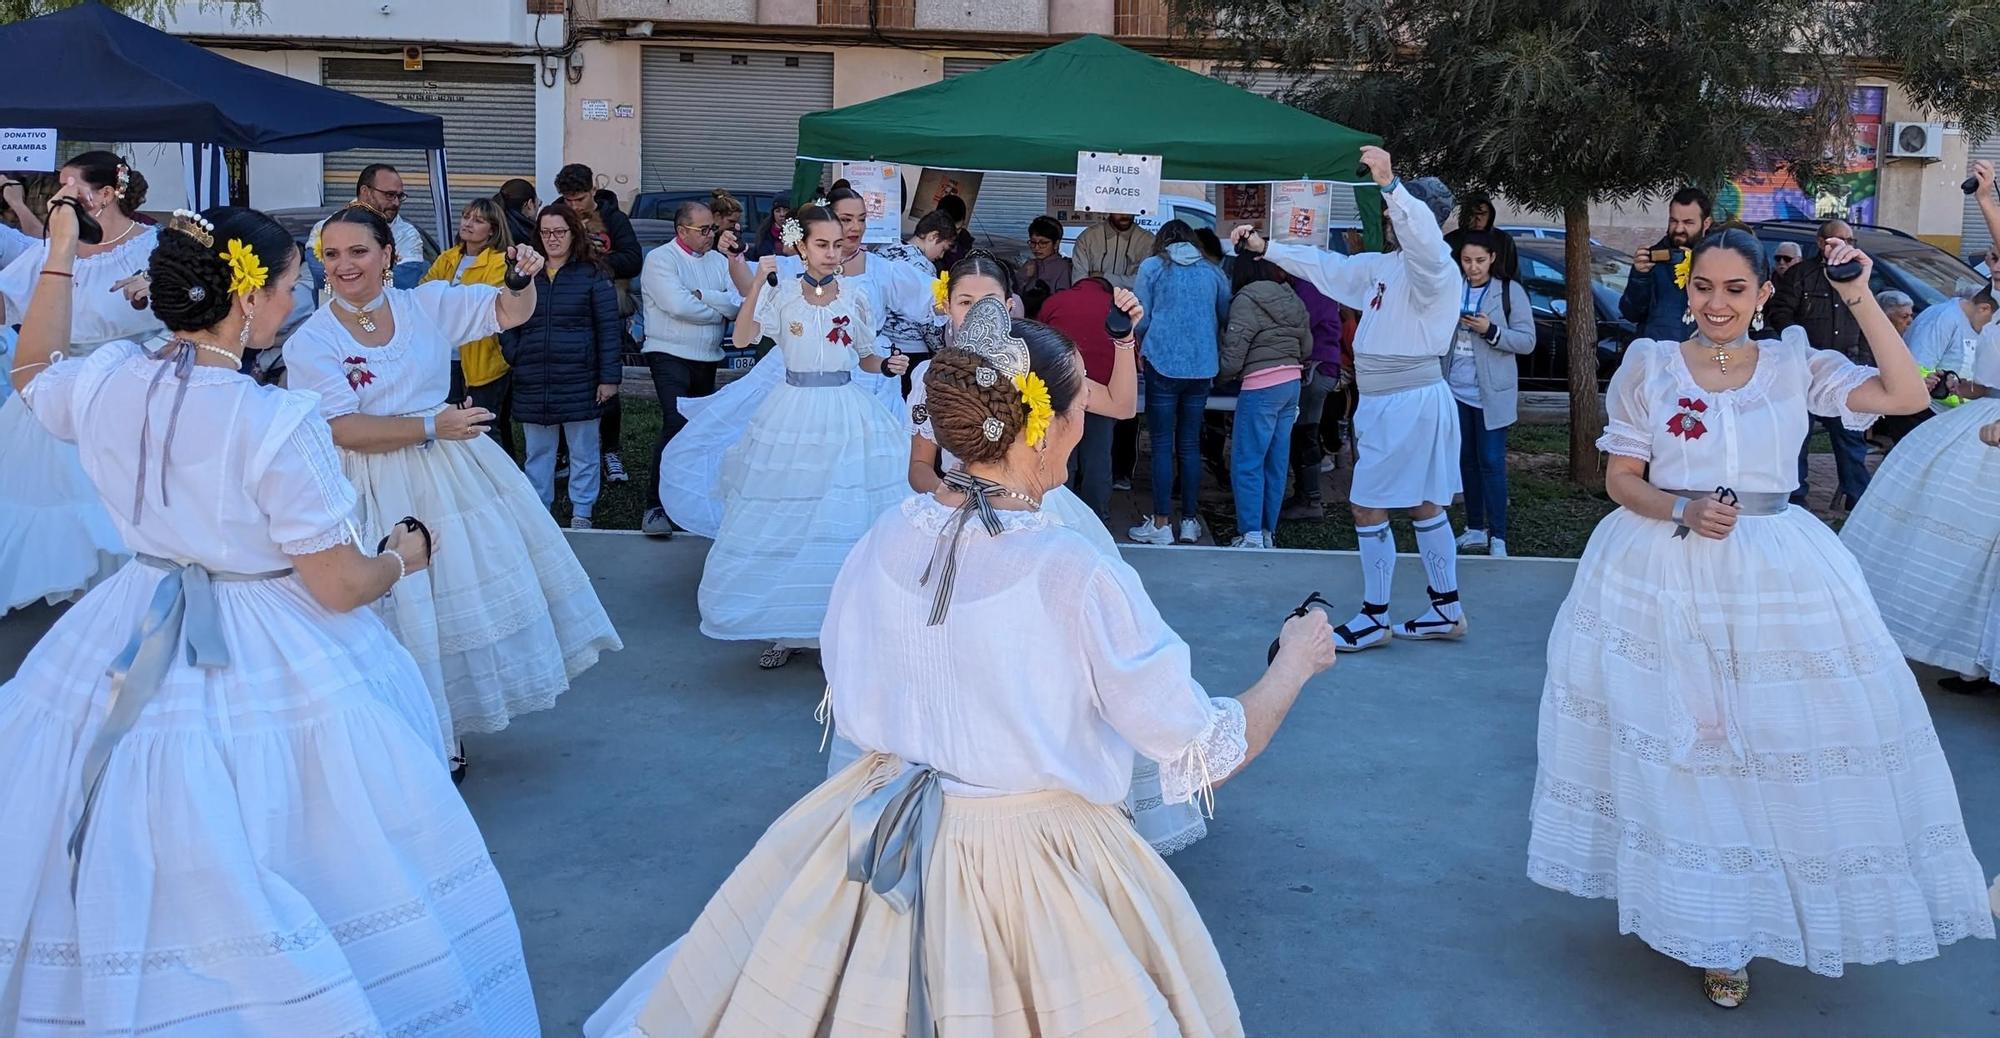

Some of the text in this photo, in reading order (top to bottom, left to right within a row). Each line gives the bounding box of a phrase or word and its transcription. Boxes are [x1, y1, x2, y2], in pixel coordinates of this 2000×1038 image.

[1098, 164, 1140, 175] HABILES
[1115, 176, 1122, 184] Y
[1095, 186, 1141, 197] CAPACES
